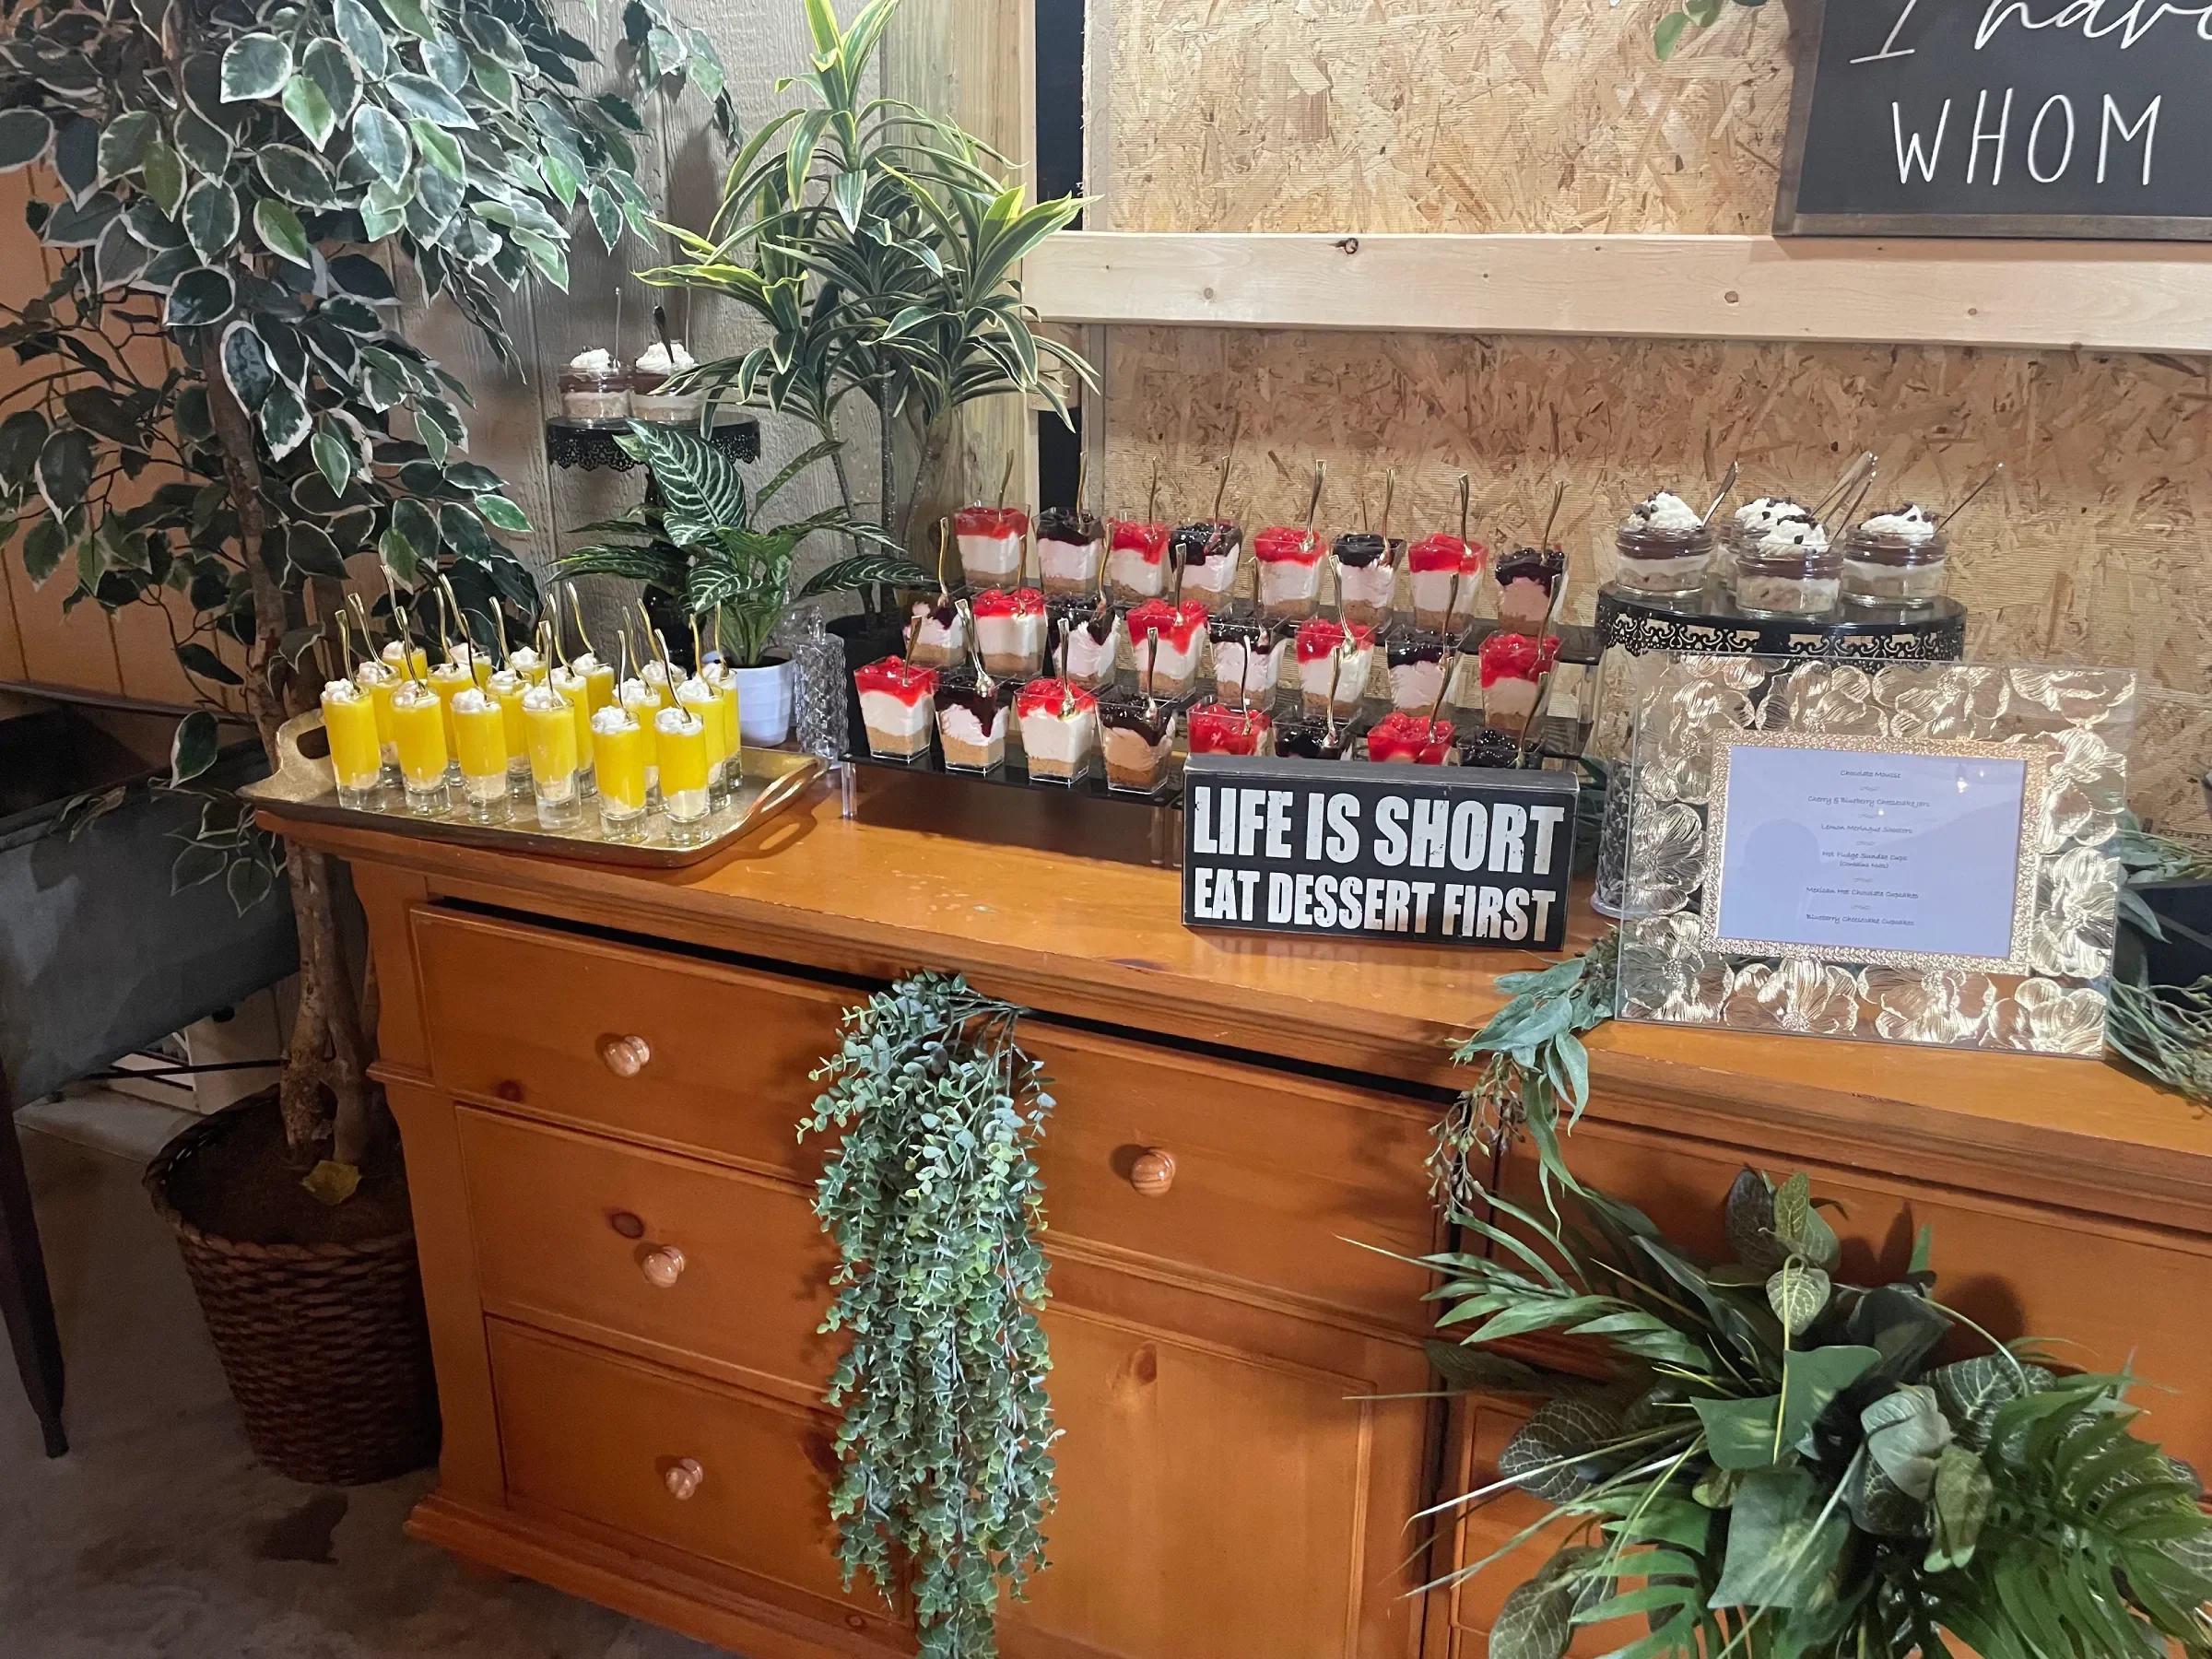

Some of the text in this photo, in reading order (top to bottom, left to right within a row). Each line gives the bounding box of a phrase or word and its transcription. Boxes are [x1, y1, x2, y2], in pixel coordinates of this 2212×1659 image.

[1891, 88, 2161, 185] WHOM
[1841, 770, 1874, 778] Chocolate
[1807, 795, 1832, 806] Cherry
[1841, 797, 1875, 807] Blueberry
[1877, 799, 1915, 807] Cheesecake
[1194, 786, 1565, 875] LIFE IS SHORT
[1847, 825, 1881, 834] Meringue
[1883, 826, 1913, 834] Shooters
[1837, 852, 1859, 861] Fudge
[1851, 889, 1884, 898] Chocolate
[1885, 891, 1919, 900] Cupcakes
[1194, 867, 1557, 942] EAT DESSERT FIRST
[1806, 913, 1915, 926] Blueberry Cheesecake Cupcakes
